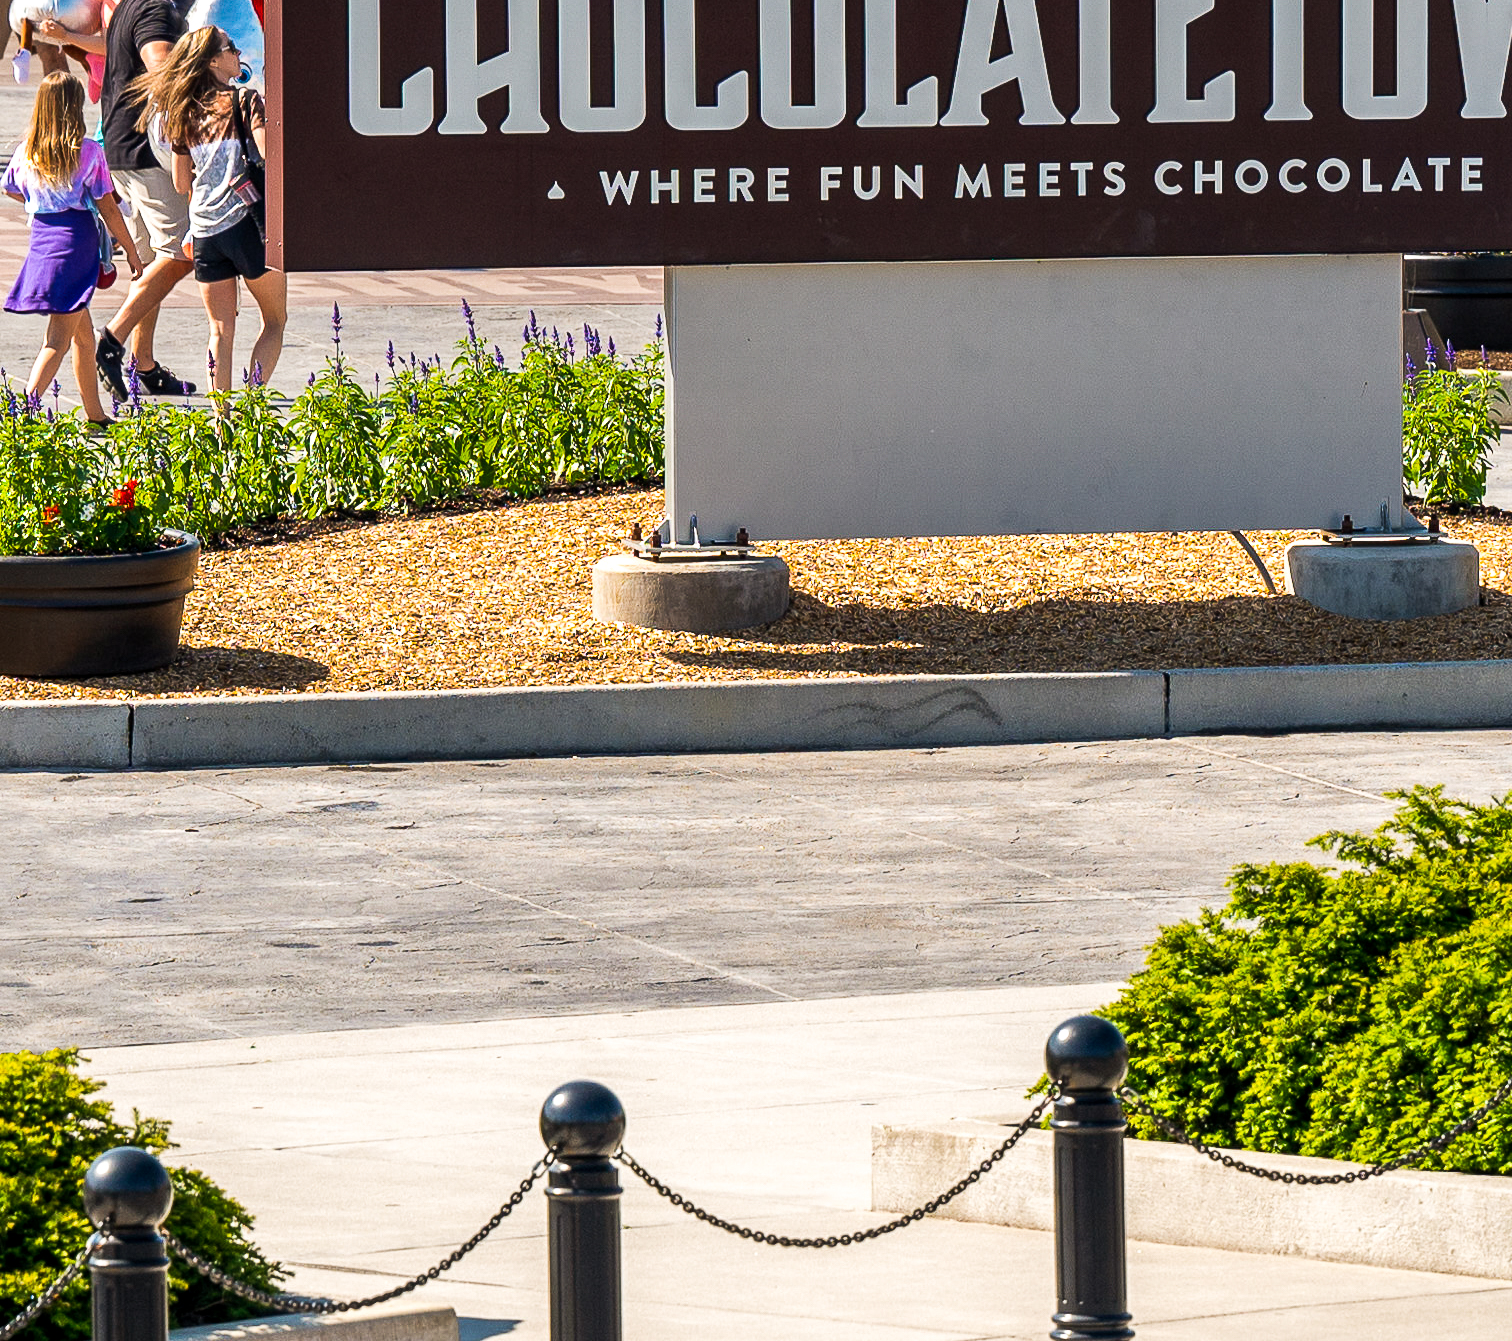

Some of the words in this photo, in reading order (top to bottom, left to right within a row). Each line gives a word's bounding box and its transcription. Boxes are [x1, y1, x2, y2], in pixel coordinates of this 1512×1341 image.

[598, 167, 791, 207] WHERE
[817, 164, 927, 203] FUN
[953, 160, 1127, 201] MEETS
[1153, 156, 1488, 198] CHOCOLATE
